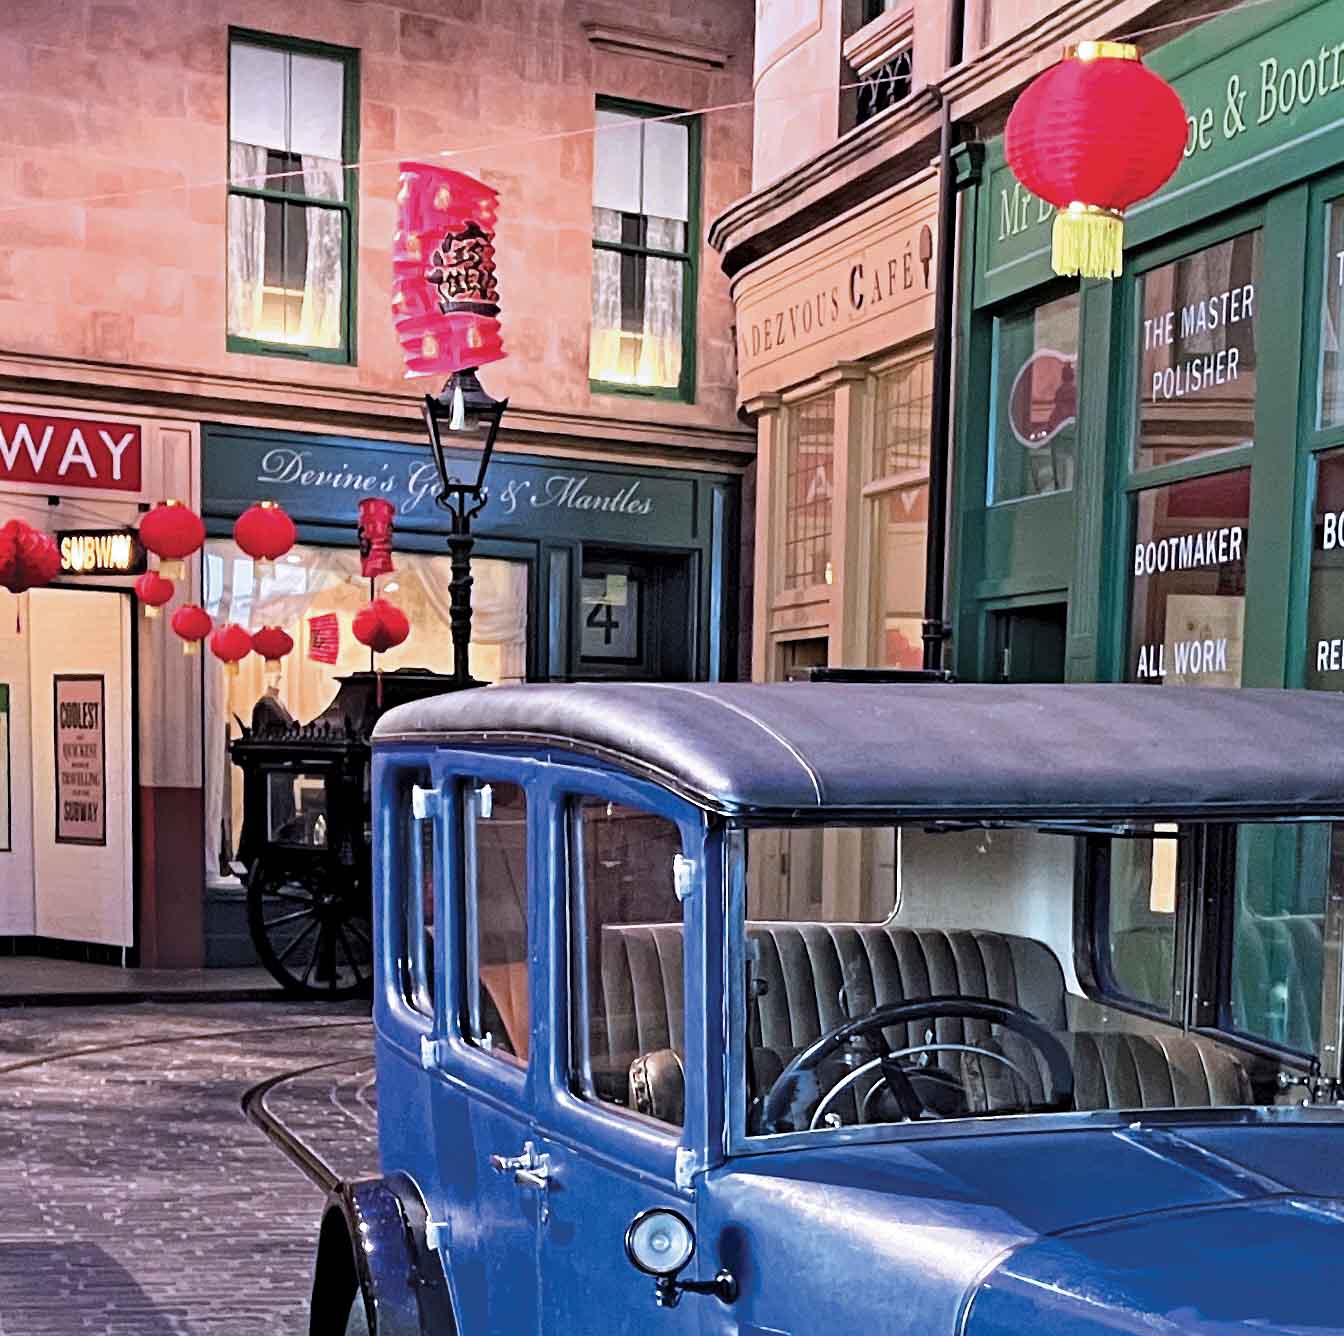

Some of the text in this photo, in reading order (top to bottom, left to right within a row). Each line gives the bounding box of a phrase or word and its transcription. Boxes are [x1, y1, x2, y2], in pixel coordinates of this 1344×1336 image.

[1183, 114, 1214, 157] oe
[1223, 74, 1247, 139] &
[998, 184, 1032, 241] Mr
[1144, 284, 1255, 351] THE MASTER
[1152, 347, 1240, 404] POLISHER
[256, 448, 398, 493] Devine's
[499, 479, 531, 513] &
[530, 475, 653, 516] Mantles
[1134, 526, 1243, 576] BOOTMAKER
[586, 603, 620, 645] 4
[1137, 638, 1228, 678] ALL WORK
[59, 702, 99, 730] COOLEST
